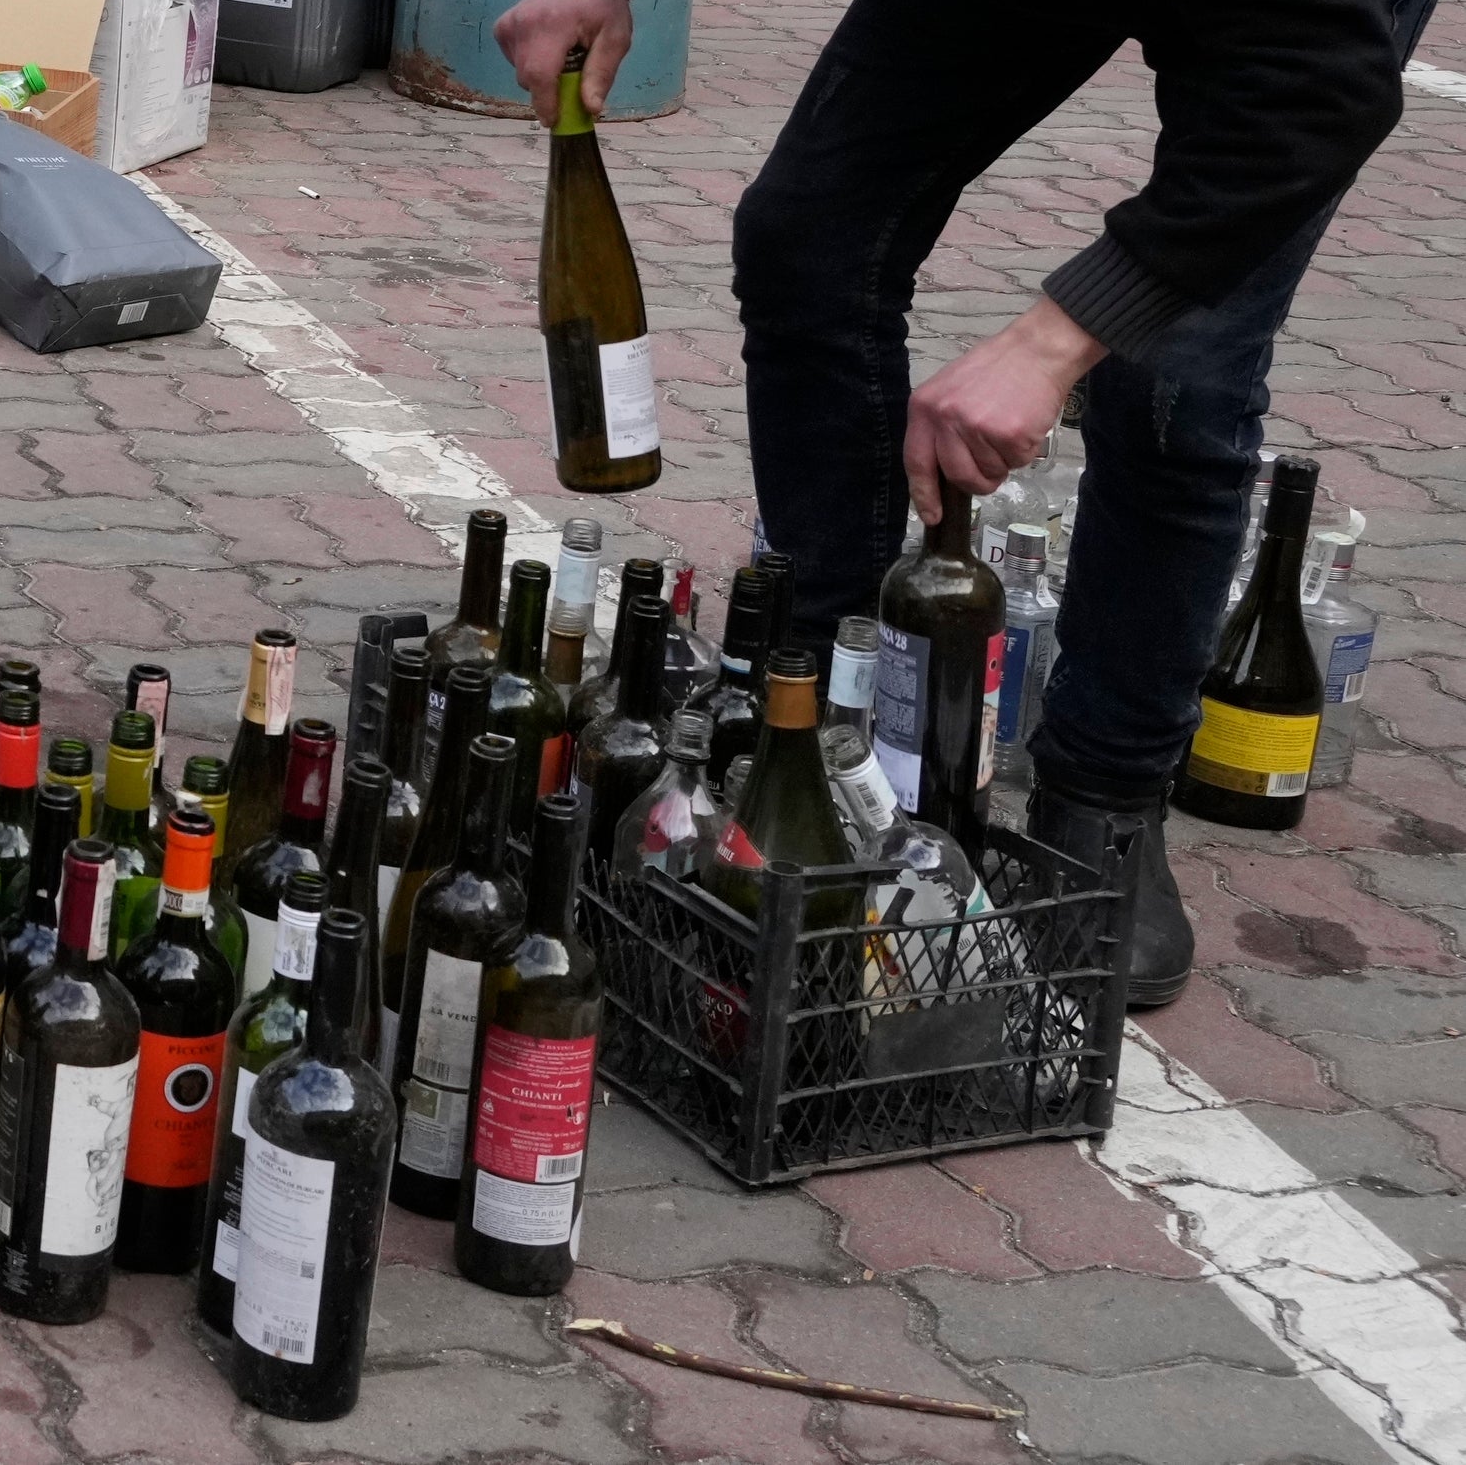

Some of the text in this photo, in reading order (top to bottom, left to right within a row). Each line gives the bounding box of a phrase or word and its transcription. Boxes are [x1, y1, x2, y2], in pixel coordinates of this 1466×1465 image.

[14, 156, 69, 164] WINETIME
[895, 634, 908, 651] 28
[431, 1006, 444, 1016] LA
[511, 1086, 563, 1102] CHIANTI
